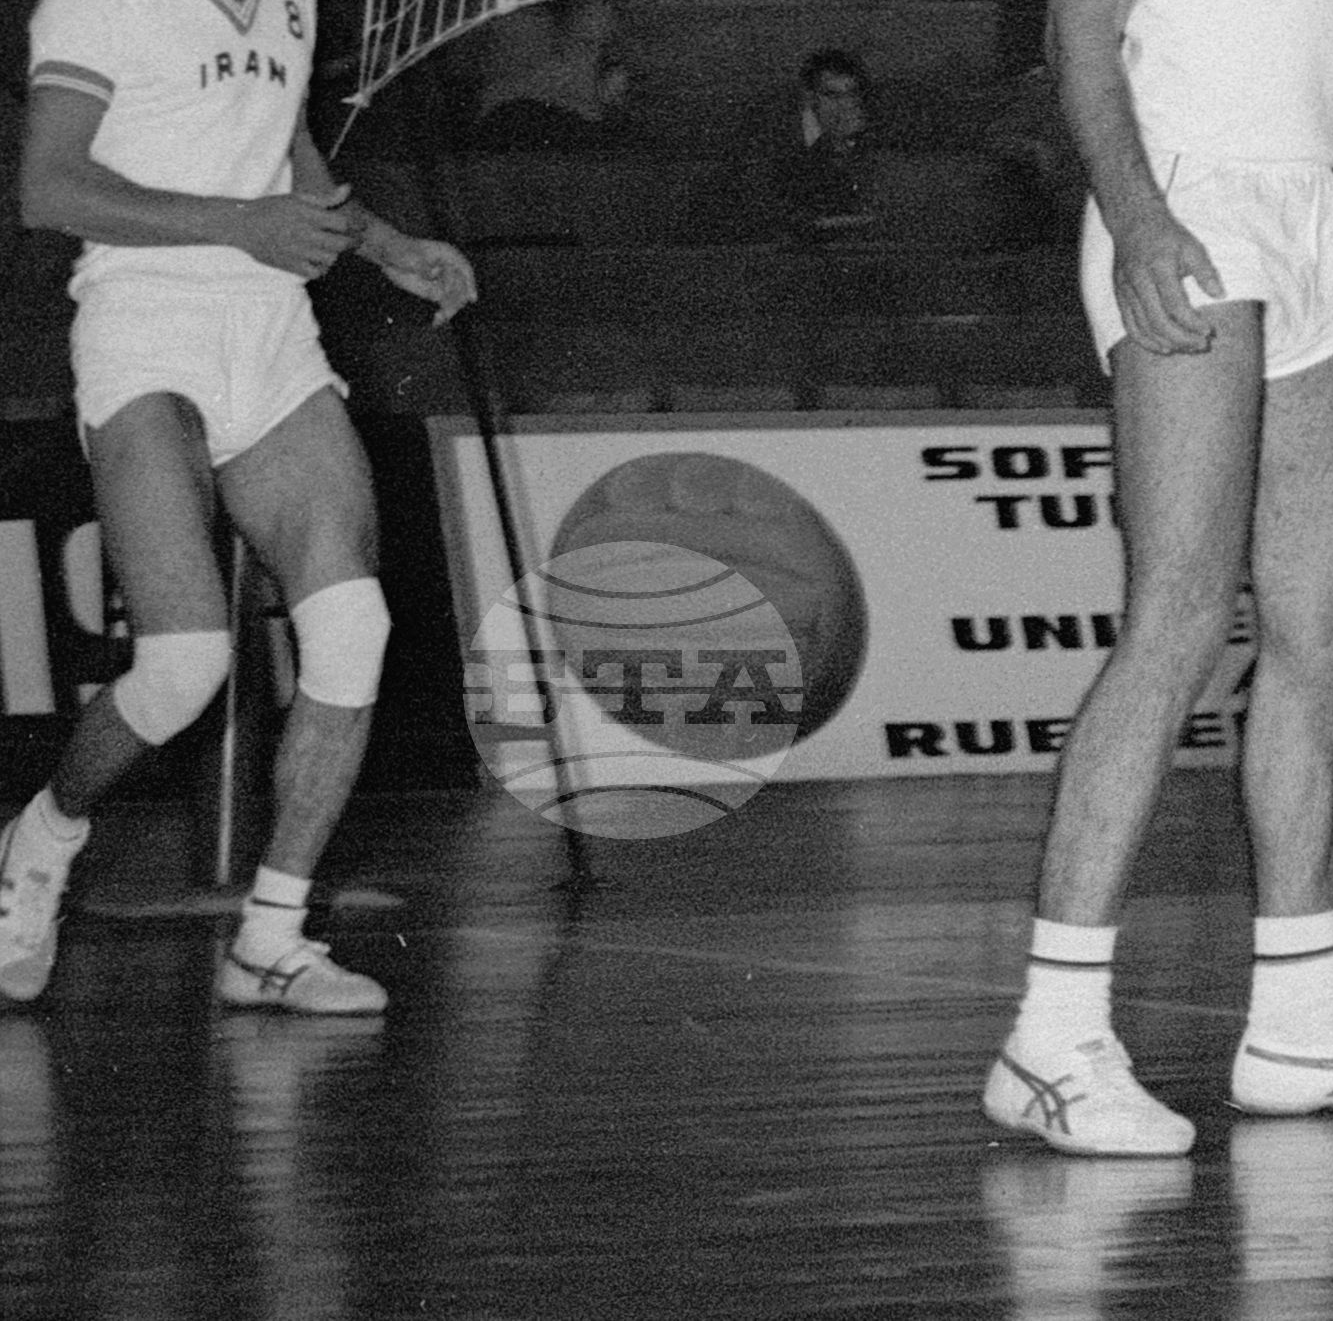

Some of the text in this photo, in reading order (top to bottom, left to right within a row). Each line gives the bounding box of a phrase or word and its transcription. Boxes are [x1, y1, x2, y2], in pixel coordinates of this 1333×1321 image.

[201, 49, 287, 89] IRAN
[921, 444, 1114, 482] SOF
[884, 718, 1070, 760] RUE
